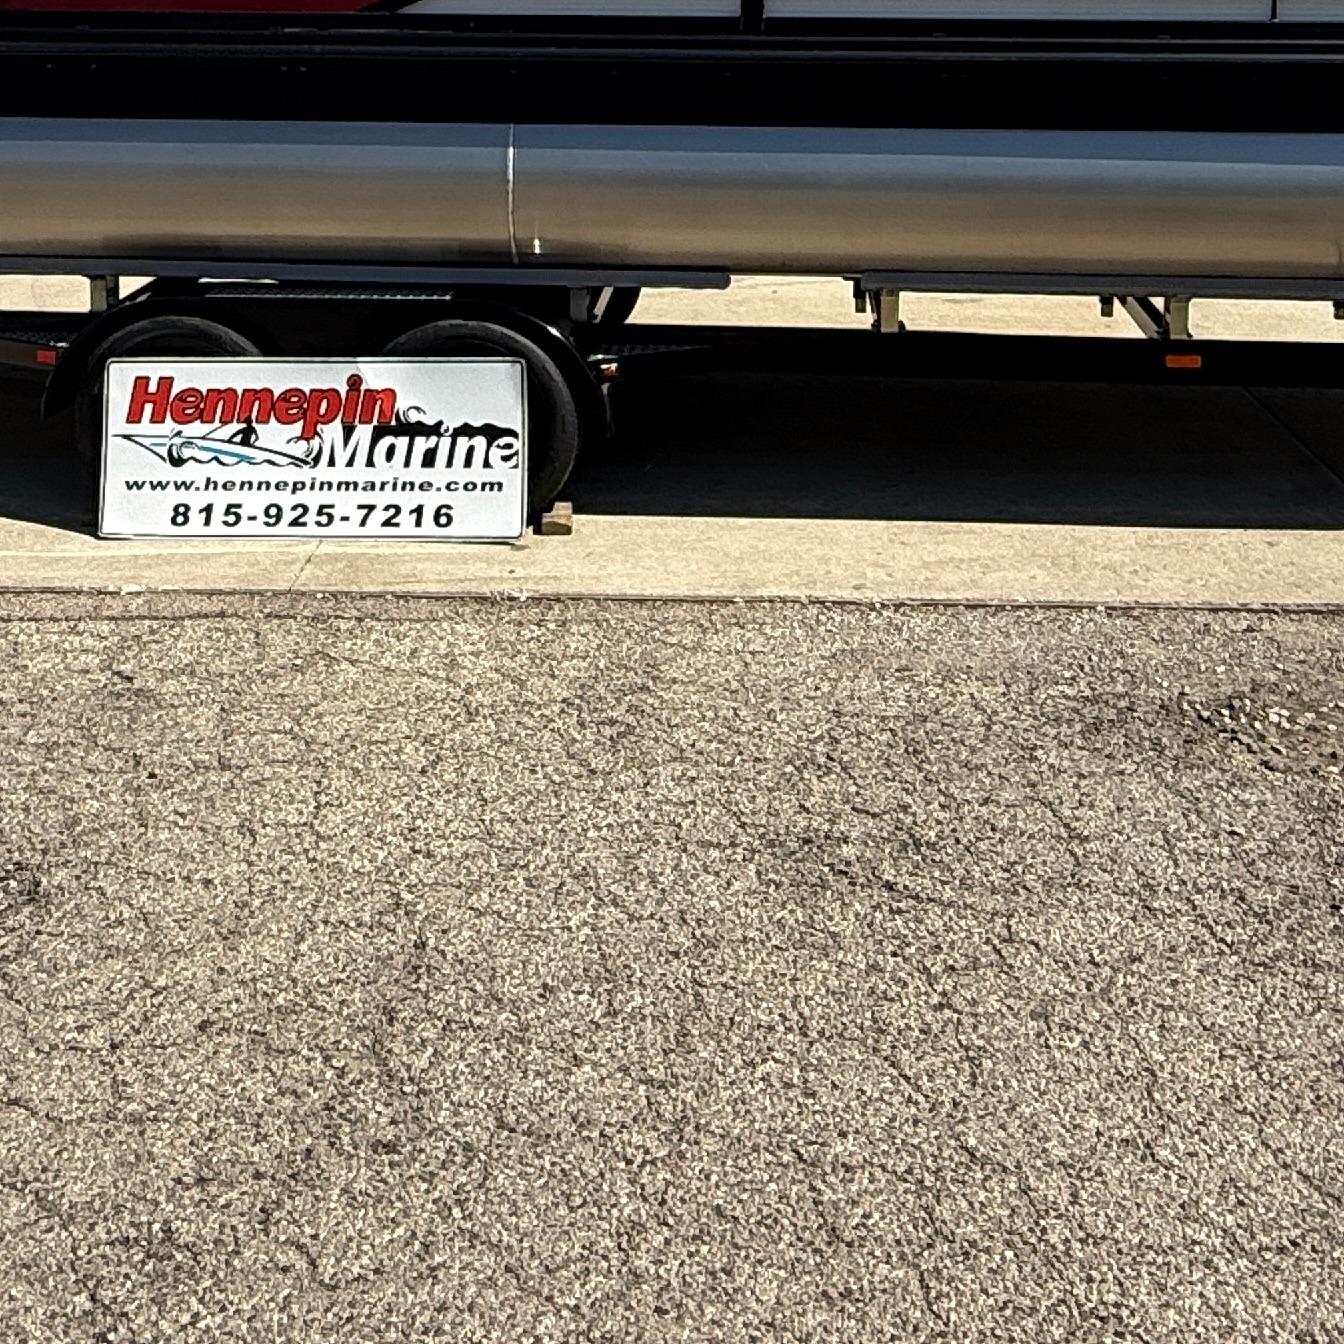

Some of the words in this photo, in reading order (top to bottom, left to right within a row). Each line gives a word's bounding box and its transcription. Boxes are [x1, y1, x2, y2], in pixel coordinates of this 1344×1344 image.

[126, 373, 397, 441] Hennepin
[316, 423, 520, 469] Marine
[124, 476, 505, 495] www.hennepinmarine.com
[170, 502, 454, 529] 815-925-7216
